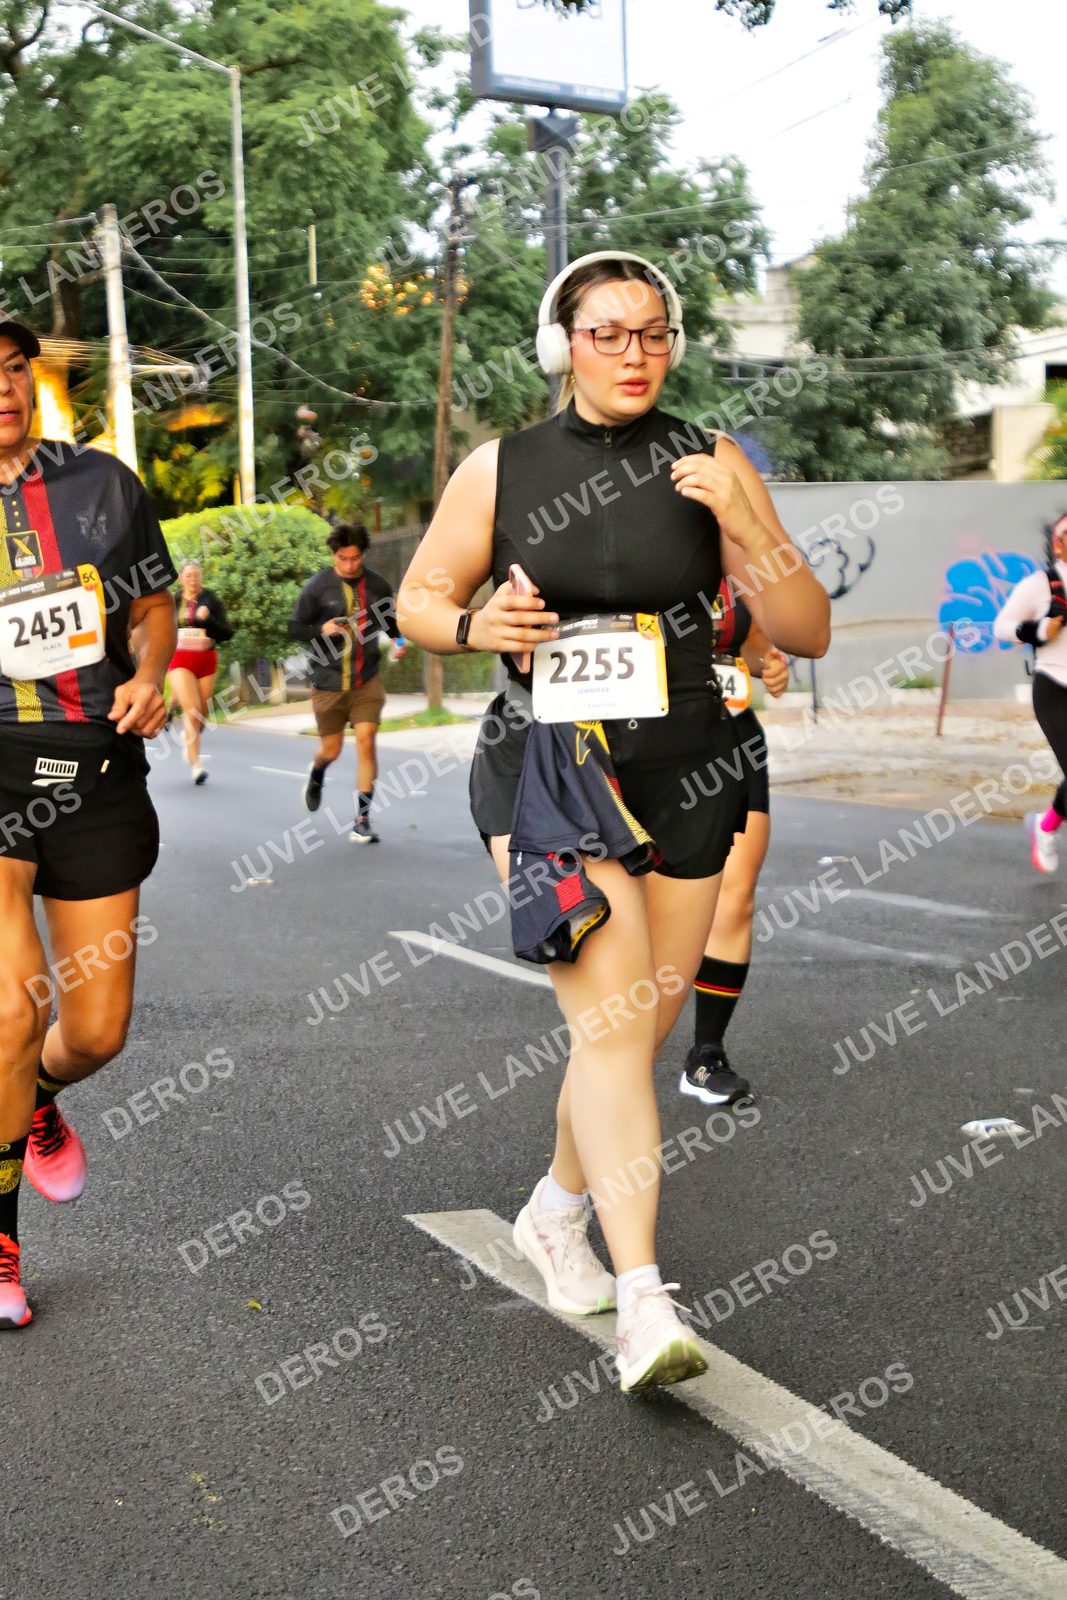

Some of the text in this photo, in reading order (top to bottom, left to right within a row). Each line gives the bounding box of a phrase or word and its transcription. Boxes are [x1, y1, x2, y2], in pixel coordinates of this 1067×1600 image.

[8, 601, 83, 648] 2451
[549, 646, 635, 684] 2255
[38, 760, 76, 774] PUMA
